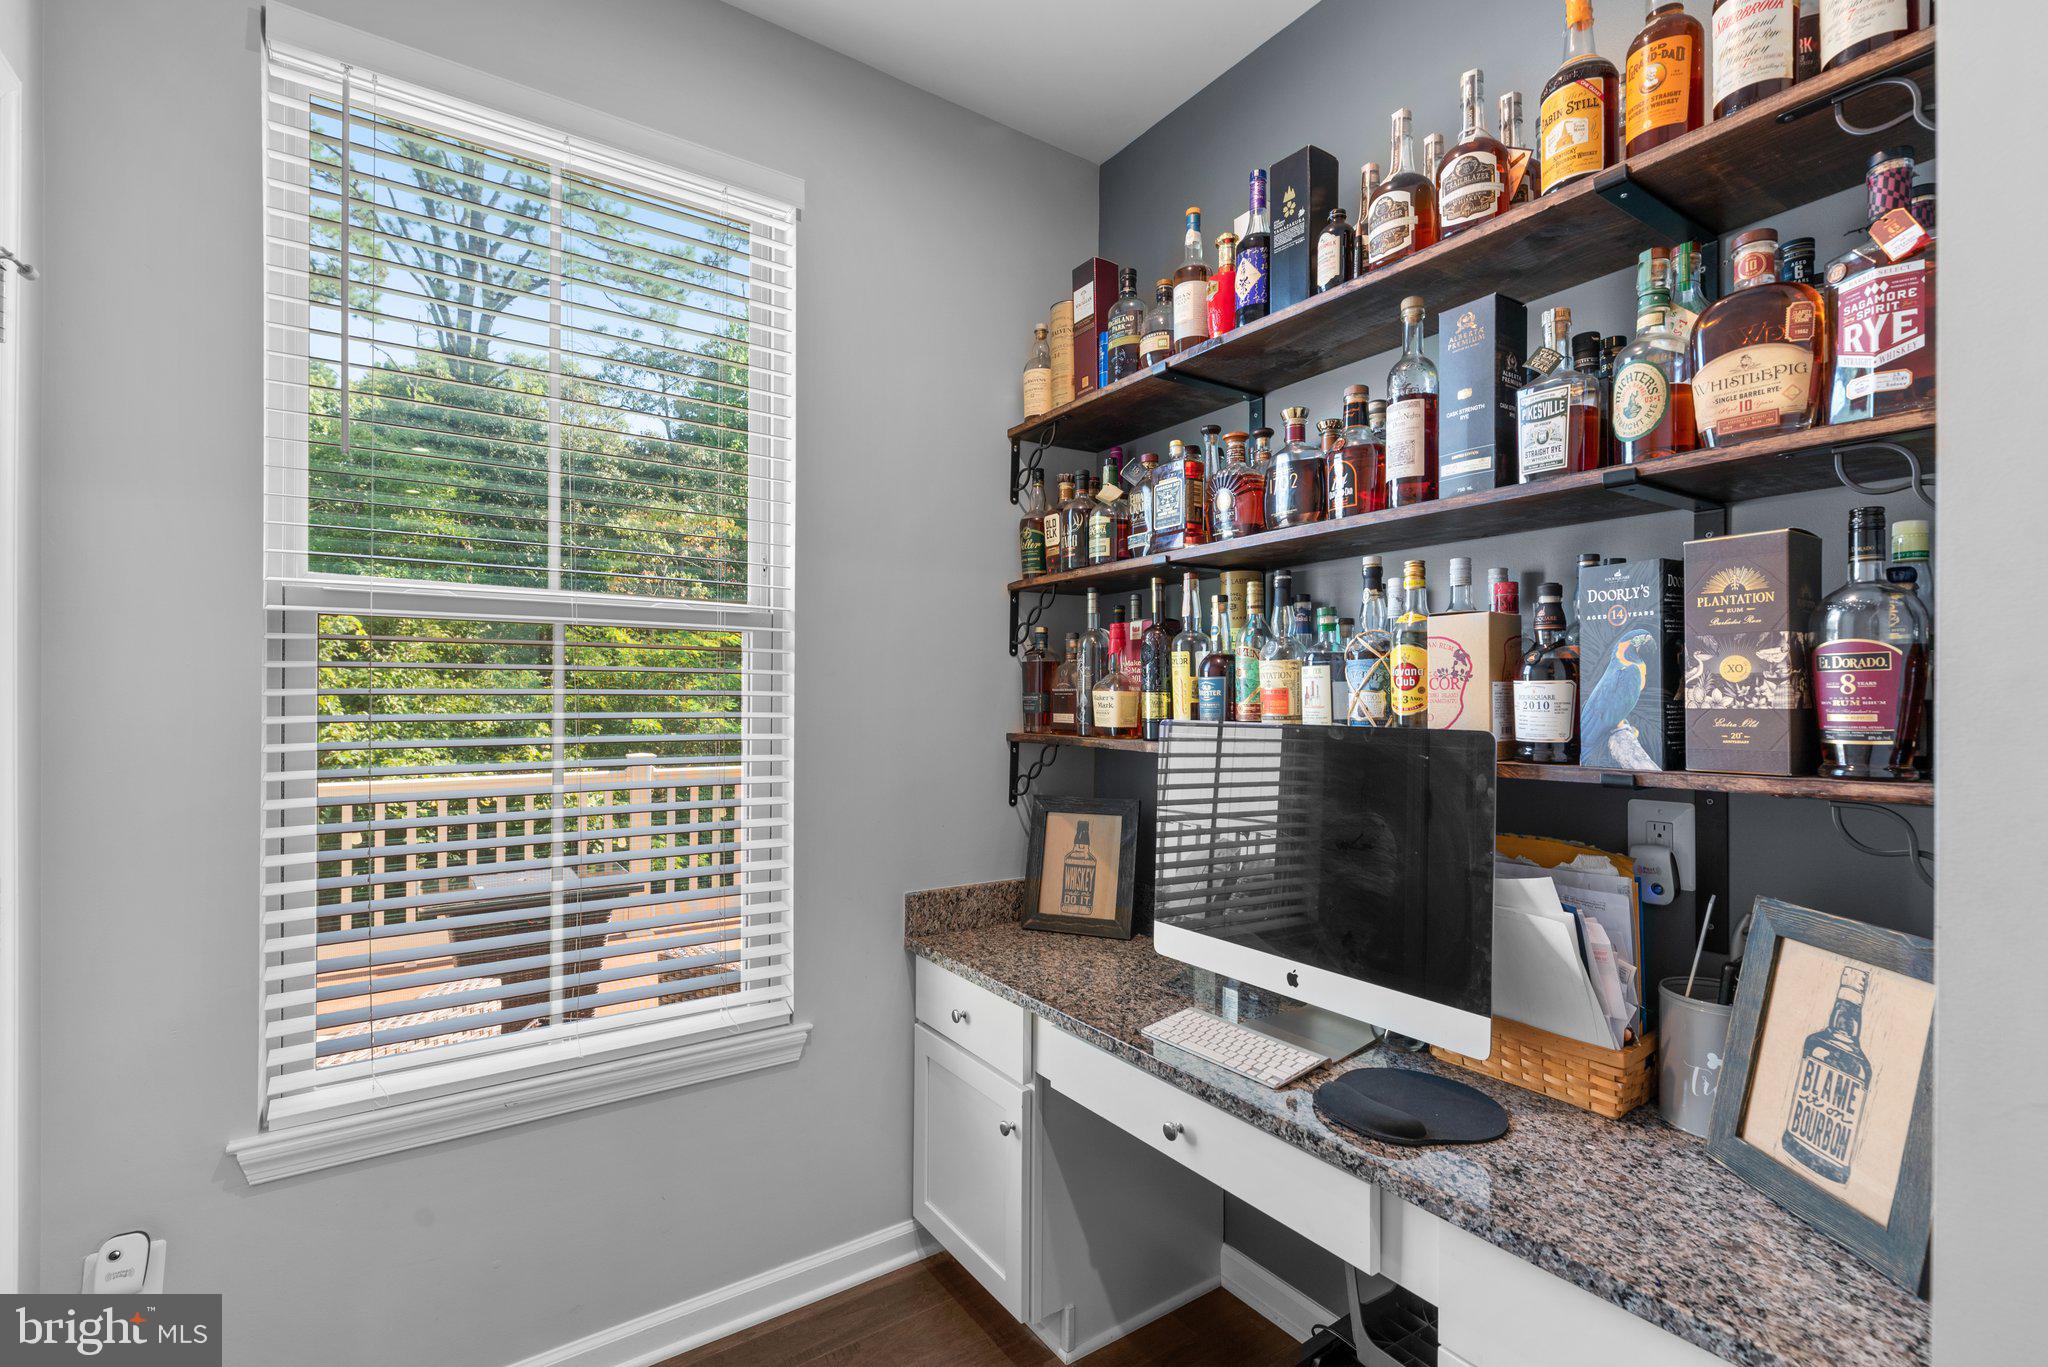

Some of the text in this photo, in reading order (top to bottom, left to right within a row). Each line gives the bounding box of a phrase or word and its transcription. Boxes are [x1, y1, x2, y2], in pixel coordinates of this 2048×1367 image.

[1565, 97, 1600, 116] STILL
[1650, 97, 1680, 110] WHISKEY
[1745, 260, 1757, 272] 10
[1794, 265, 1804, 279] 6
[1879, 264, 1911, 275] SELECT
[1843, 288, 1918, 316] SAGAMORE
[1856, 301, 1900, 321] SPIRIT
[1843, 308, 1918, 353] RYE
[1693, 362, 1809, 397] WHISTLEPIG
[1740, 389, 1765, 399] BARREL
[1446, 403, 1485, 419] CASK STRENGTH
[1521, 400, 1565, 421] PIKESVILLE
[1645, 403, 1658, 419] RYE
[1739, 400, 1752, 413] 10
[1525, 445, 1562, 459] STRAIGHT RYE
[1045, 518, 1057, 530] OLD
[1046, 527, 1057, 539] ELK
[1587, 584, 1650, 603] DOORLY'S
[1697, 591, 1775, 608] PLANTATION
[1612, 608, 1624, 620] 14
[1627, 610, 1655, 618] YEARS
[1727, 664, 1744, 673] XO
[1818, 657, 1831, 669] EL
[1396, 676, 1416, 687] Club
[1429, 678, 1461, 691] COR
[1840, 673, 1856, 695] 8
[1402, 695, 1409, 704] 3
[1523, 701, 1550, 710] 2010
[1064, 866, 1096, 892] WHISKEY
[1064, 895, 1077, 904] DO
[1802, 1060, 1860, 1115] BLAME
[1799, 1094, 1853, 1125] it on
[1791, 1100, 1851, 1161] BOURBON
